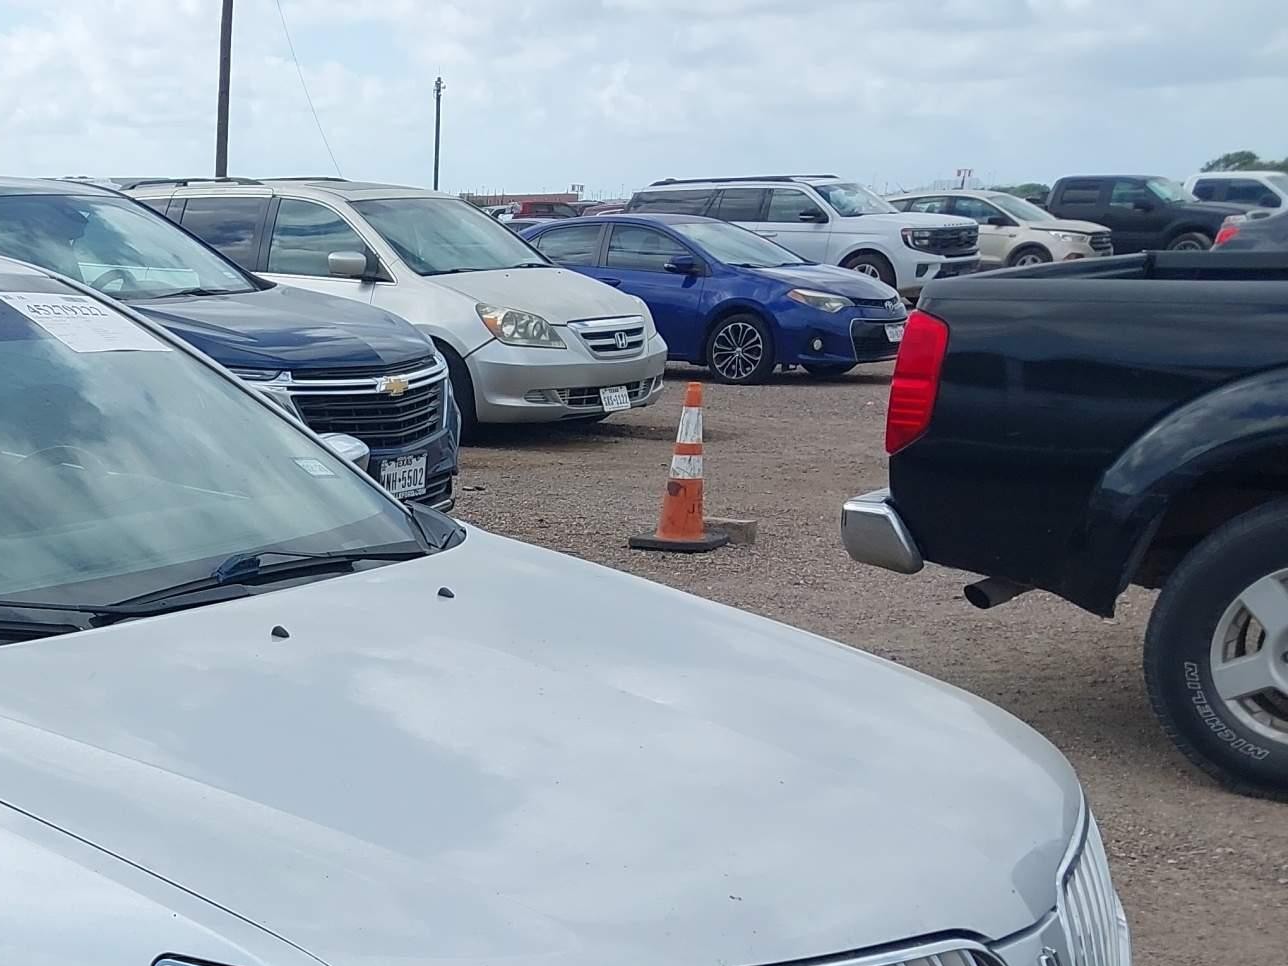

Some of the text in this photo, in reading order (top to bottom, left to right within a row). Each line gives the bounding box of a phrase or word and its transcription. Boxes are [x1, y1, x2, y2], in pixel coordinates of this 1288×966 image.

[26, 303, 109, 317] 45279222
[395, 457, 413, 468] TEXAS
[1184, 660, 1270, 760] MICHELIN
